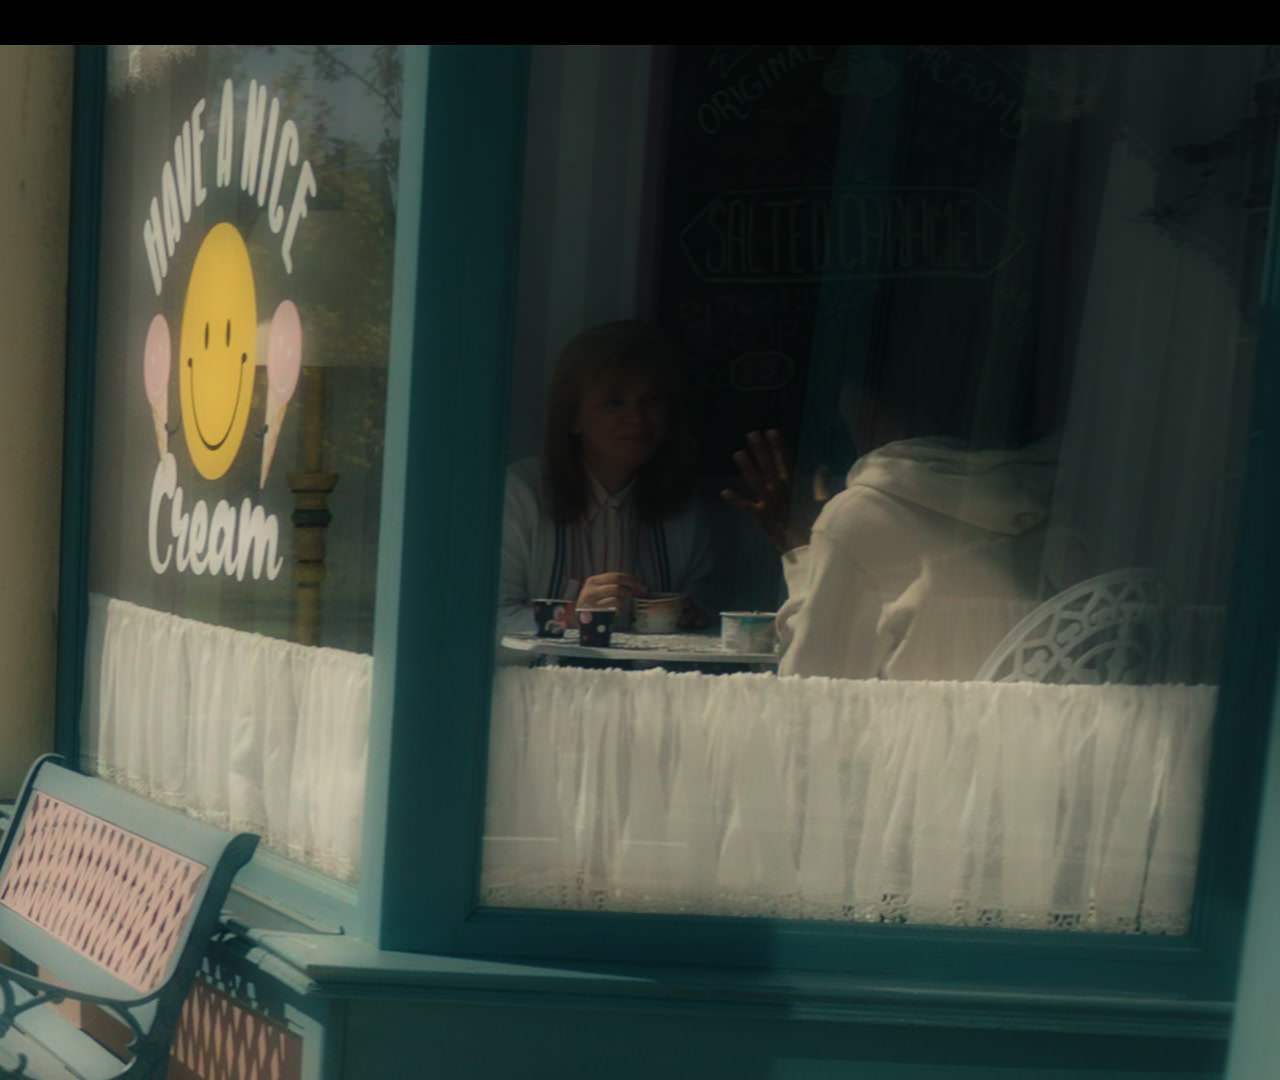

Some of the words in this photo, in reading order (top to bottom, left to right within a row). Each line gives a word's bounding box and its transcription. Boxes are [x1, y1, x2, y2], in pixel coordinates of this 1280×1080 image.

[143, 98, 207, 296] HAVE
[216, 78, 235, 188] A
[240, 79, 316, 274] NICE
[706, 197, 831, 273] SALTED
[148, 452, 283, 582] Cream
